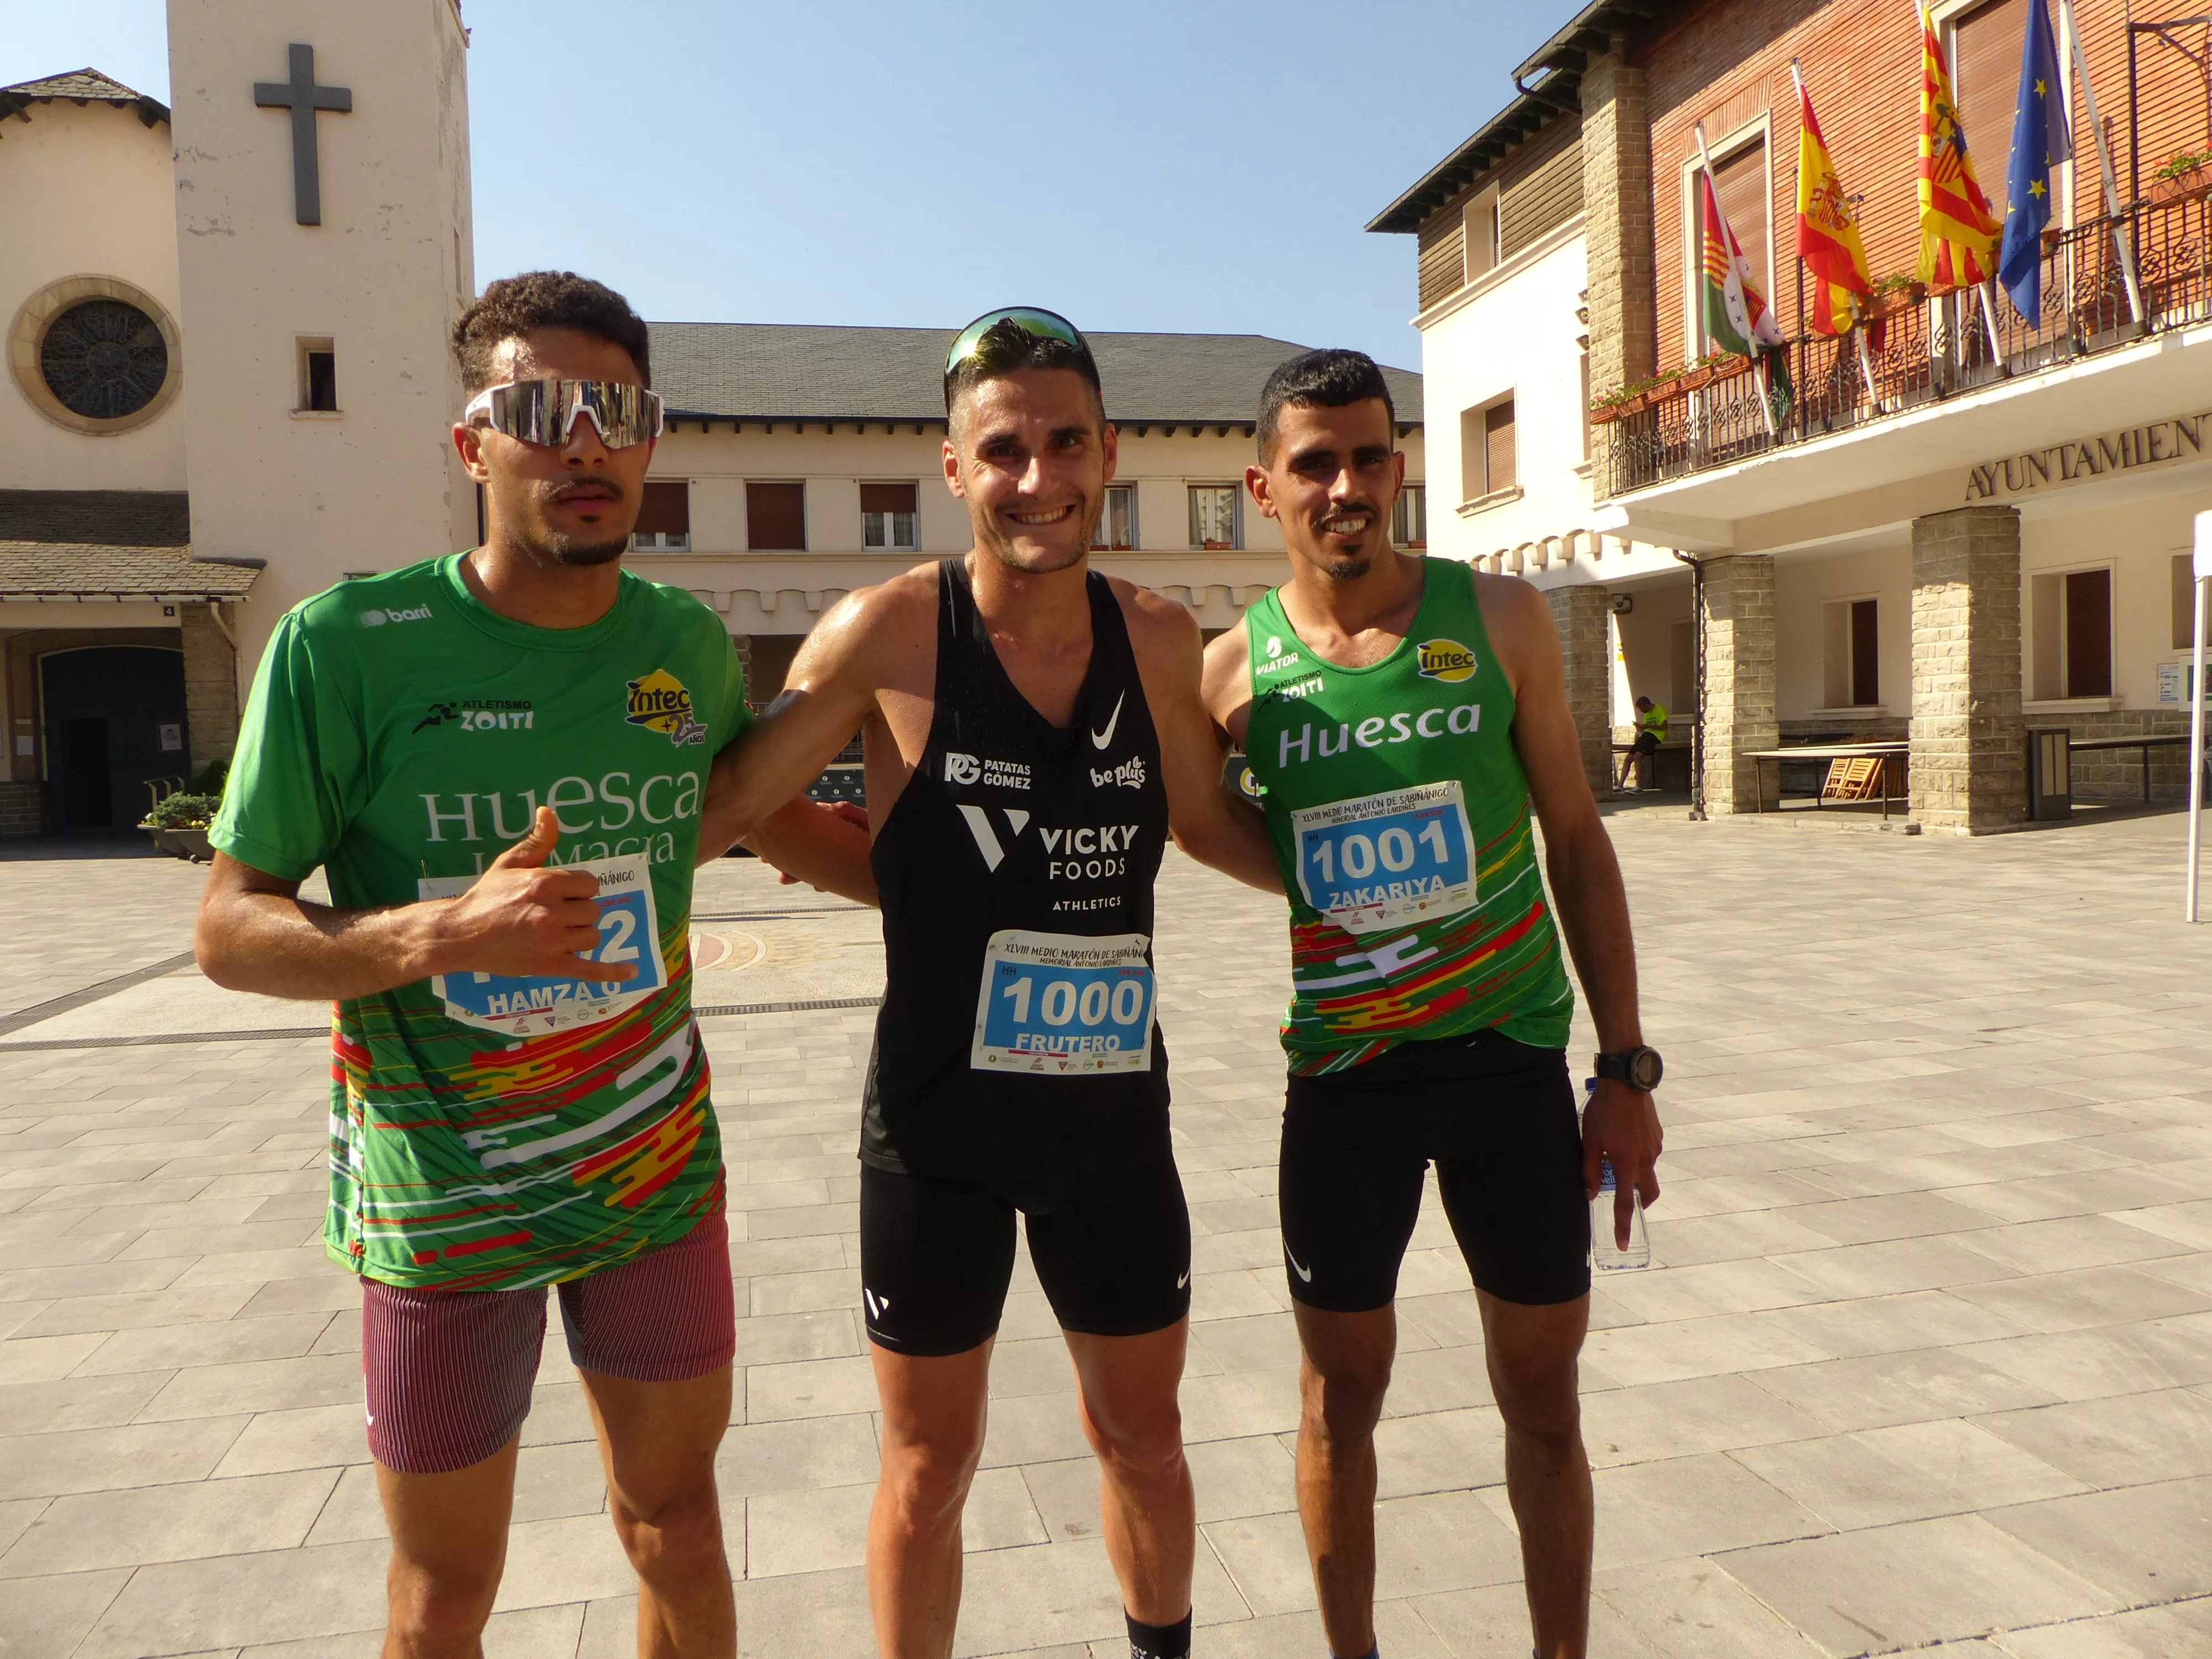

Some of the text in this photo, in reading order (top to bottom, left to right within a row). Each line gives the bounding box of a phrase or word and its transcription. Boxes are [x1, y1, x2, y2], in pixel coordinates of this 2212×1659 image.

[166, 607, 172, 615] 4
[385, 603, 433, 623] barri
[1256, 652, 1299, 675] VIATOR
[1280, 670, 1322, 688] ATLETISMO
[1282, 677, 1324, 703] ZOITI
[462, 700, 531, 709] ATLETISMO
[461, 711, 534, 732] ZOITI
[689, 733, 705, 745] AÑOS
[1279, 704, 1481, 769] Huesca
[984, 759, 1031, 775] PATATAS
[1090, 761, 1146, 789] be plus
[983, 771, 1031, 790] GÓMEZ
[419, 771, 700, 842] Huesca
[1302, 787, 1449, 823] XLVIII MEDIO MARATÓN DE SABIÑÁNIGO
[1332, 815, 1357, 824] MEMORIAL
[1359, 809, 1386, 819] ANTONIO
[1387, 802, 1416, 815] LARDIÑES
[1039, 825, 1139, 855] VICKY
[1312, 820, 1449, 883] 1001
[1050, 858, 1125, 880] FOODS
[1329, 875, 1446, 909] ZAKARIYA
[1053, 896, 1121, 911] ATHLETICS
[1004, 943, 1143, 960] XLVIII MEDIO MARATÓN DE SABIÑÁNI
[1040, 957, 1072, 966] MEMORIAL
[1073, 958, 1099, 967] ANTONIO
[1002, 966, 1016, 975] MM
[487, 982, 595, 1016] HAMZA
[1004, 977, 1143, 1026] 1000
[1015, 1033, 1120, 1052] FRUTERO
